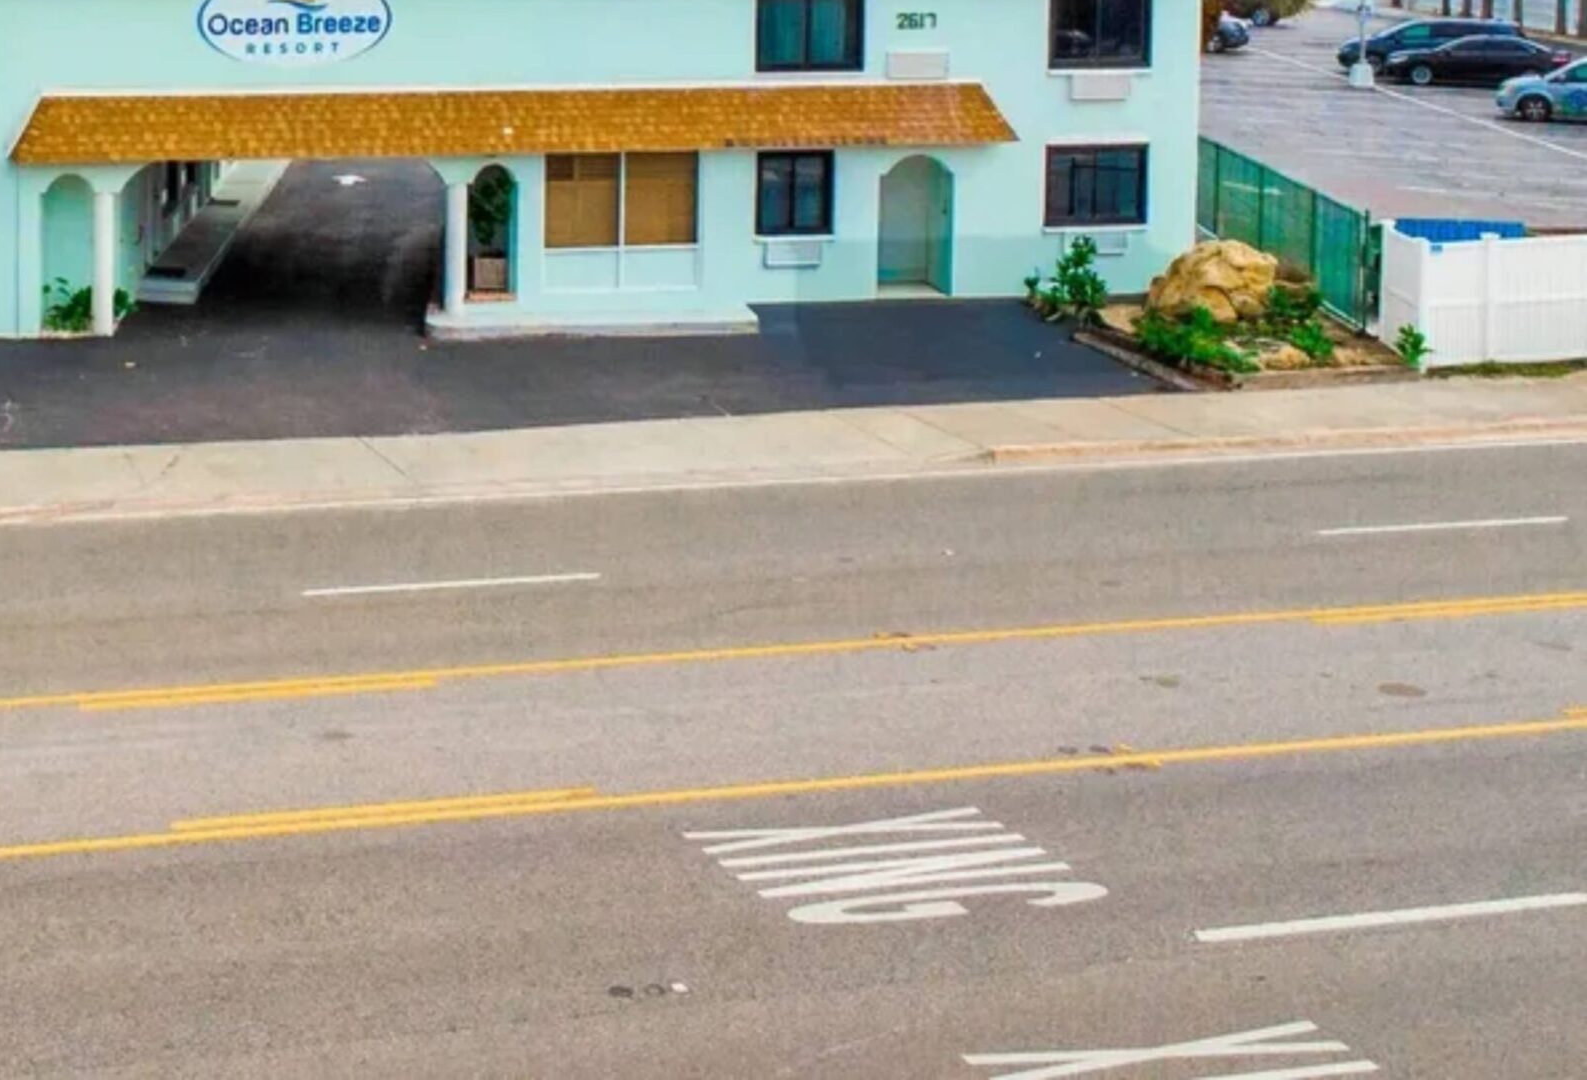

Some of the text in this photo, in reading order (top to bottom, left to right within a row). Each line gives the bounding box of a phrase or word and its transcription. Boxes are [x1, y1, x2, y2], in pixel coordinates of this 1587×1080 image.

[208, 13, 381, 36] Ocean Breeze
[896, 12, 937, 30] 2617
[245, 42, 340, 54] RESORT
[682, 806, 1109, 924] XING
